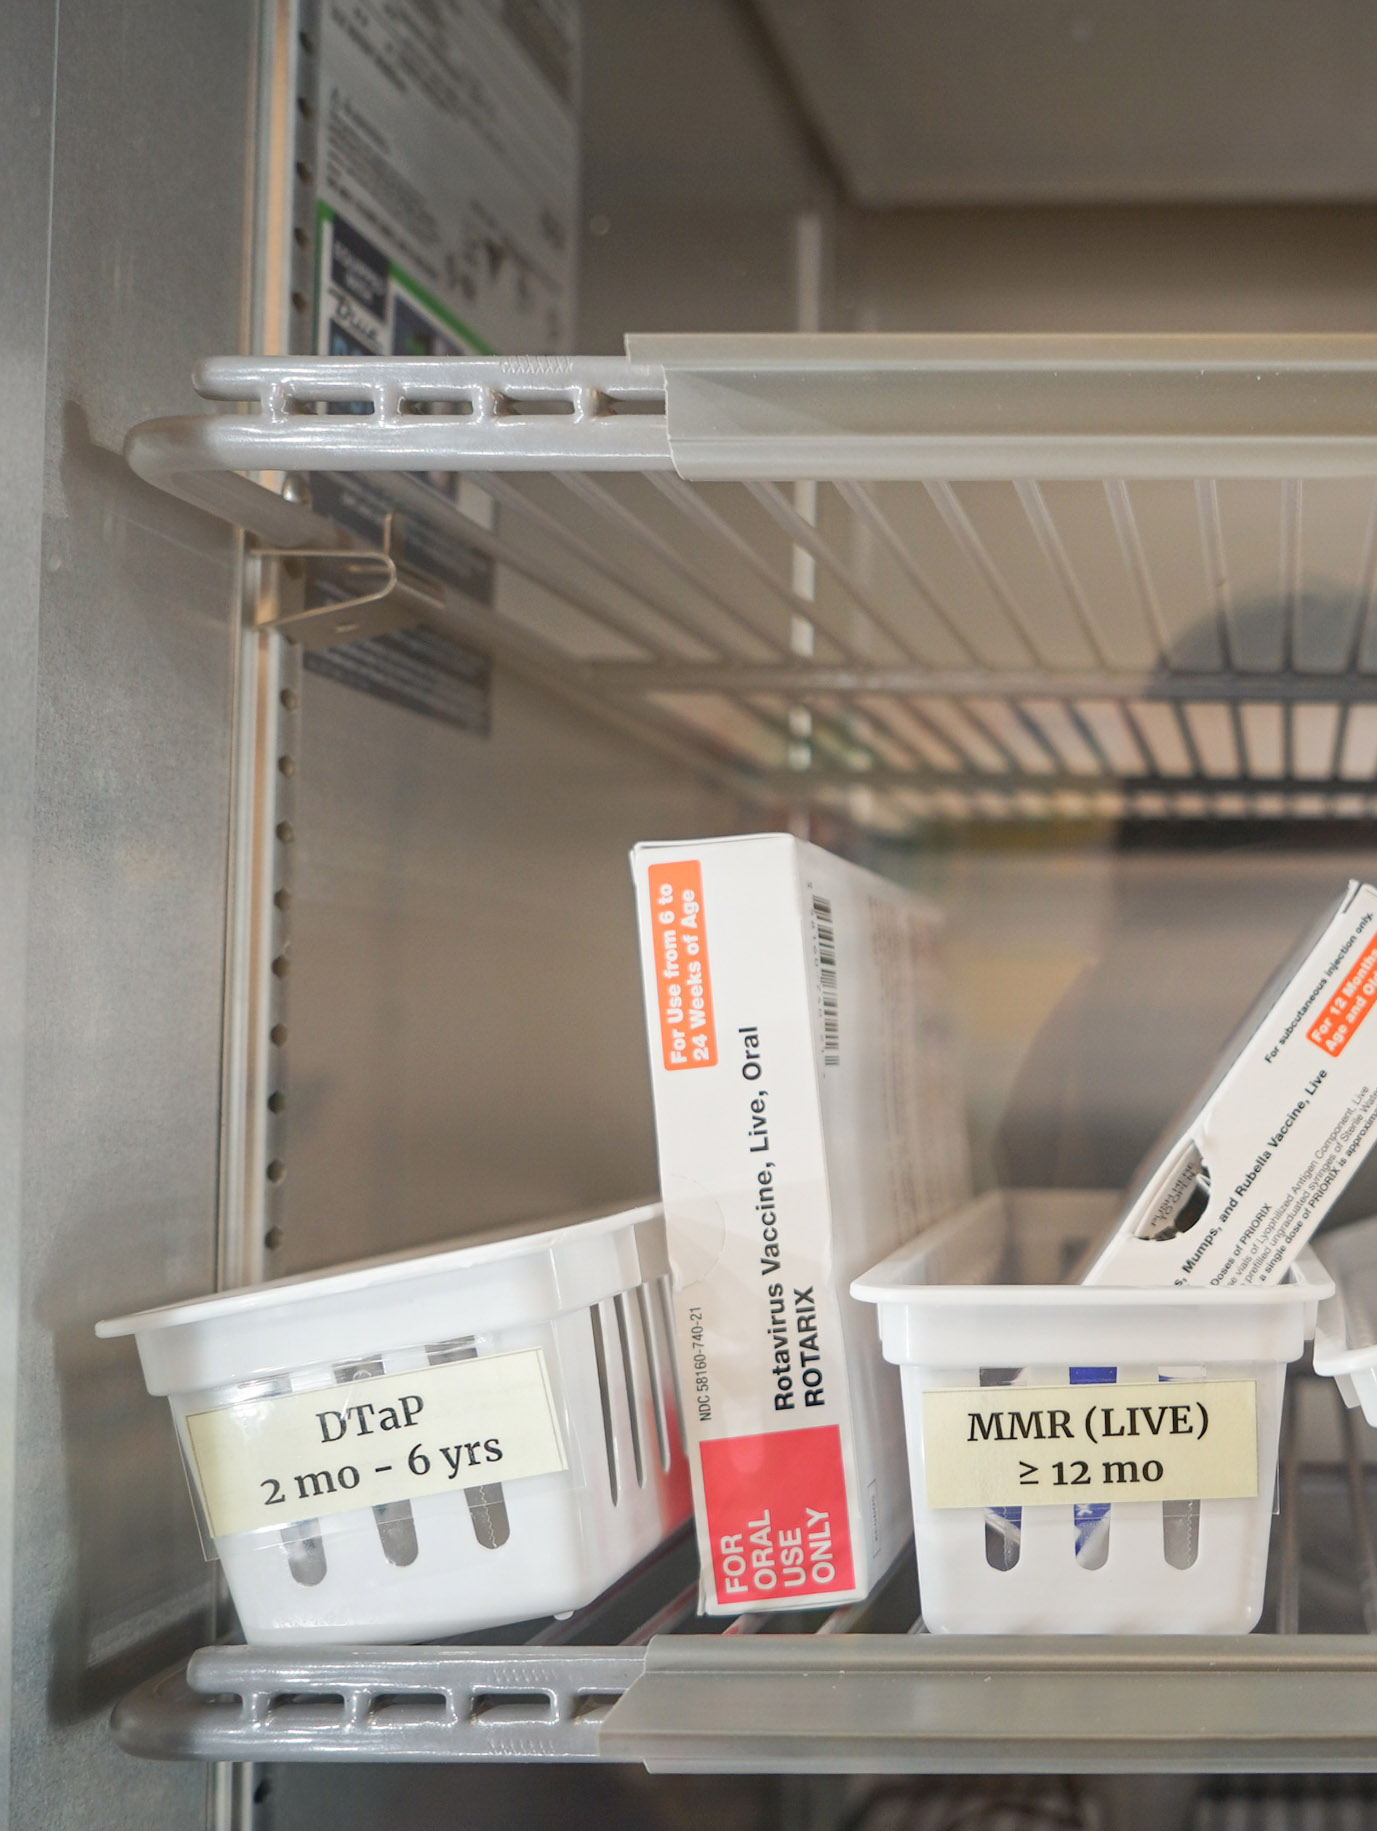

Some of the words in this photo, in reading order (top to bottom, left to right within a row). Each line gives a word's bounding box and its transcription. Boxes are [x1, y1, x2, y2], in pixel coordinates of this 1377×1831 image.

[657, 883, 673, 905] to
[658, 910, 675, 924] 6
[679, 889, 699, 928] Age
[662, 929, 680, 978] from
[681, 934, 699, 955] of
[666, 983, 683, 1024] Use
[685, 960, 706, 1029] Weeks
[1262, 1044, 1280, 1064] For
[1277, 977, 1328, 1046] subcutaneous
[1324, 933, 1358, 978] injection
[1354, 912, 1374, 935] only.
[669, 1028, 687, 1064] For
[691, 1033, 709, 1061] 24
[1309, 1016, 1332, 1043] For
[1328, 995, 1348, 1015] 12
[1323, 1023, 1348, 1052] Age
[1344, 994, 1367, 1024] and
[737, 1026, 761, 1080] Oral
[748, 1090, 769, 1152] Live,
[1180, 1225, 1222, 1274] Mumps,
[1218, 1195, 1239, 1224] and
[1233, 1149, 1272, 1198] Rubella
[1266, 1098, 1310, 1148] Vaccine,
[1303, 1068, 1328, 1096] Live
[1234, 1255, 1253, 1276] vials
[1248, 1241, 1260, 1256] of
[1254, 1192, 1295, 1245] Lyophilized
[1289, 1159, 1319, 1195] Antigen
[1313, 1106, 1355, 1160] Component,
[1351, 1084, 1370, 1106] Live
[1243, 1245, 1272, 1284] prefilled
[1268, 1188, 1311, 1247] ungraduated
[1307, 1153, 1337, 1192] syringes
[1332, 1139, 1344, 1154] of
[1338, 1112, 1364, 1143] Sterile
[754, 1161, 780, 1276] Vaccine,
[1237, 1203, 1273, 1246] PRIORIX
[1258, 1273, 1267, 1282] a
[1263, 1244, 1287, 1274] single
[1283, 1219, 1304, 1245] dose
[1300, 1206, 1312, 1220] of
[1306, 1167, 1341, 1209] PRIORIX
[1336, 1157, 1348, 1168] is
[1232, 1243, 1244, 1257] of
[688, 1306, 709, 1392] 58160-740-21
[766, 1283, 795, 1411] Rotavirus
[793, 1286, 824, 1407] ROTARIX
[315, 1394, 423, 1443] DTaP
[696, 1394, 711, 1421] NDC
[966, 1409, 1075, 1441] MMR
[1084, 1401, 1208, 1444] (LIVE)
[259, 1478, 285, 1505] 2
[293, 1465, 360, 1499] mo
[407, 1442, 430, 1475] 6
[438, 1438, 503, 1479] yrs
[1051, 1460, 1091, 1485] 12
[1101, 1459, 1164, 1483] mo
[719, 1533, 748, 1594] FOR
[747, 1508, 777, 1590] ORAL
[778, 1527, 806, 1587] USE
[805, 1507, 835, 1584] ONLY
